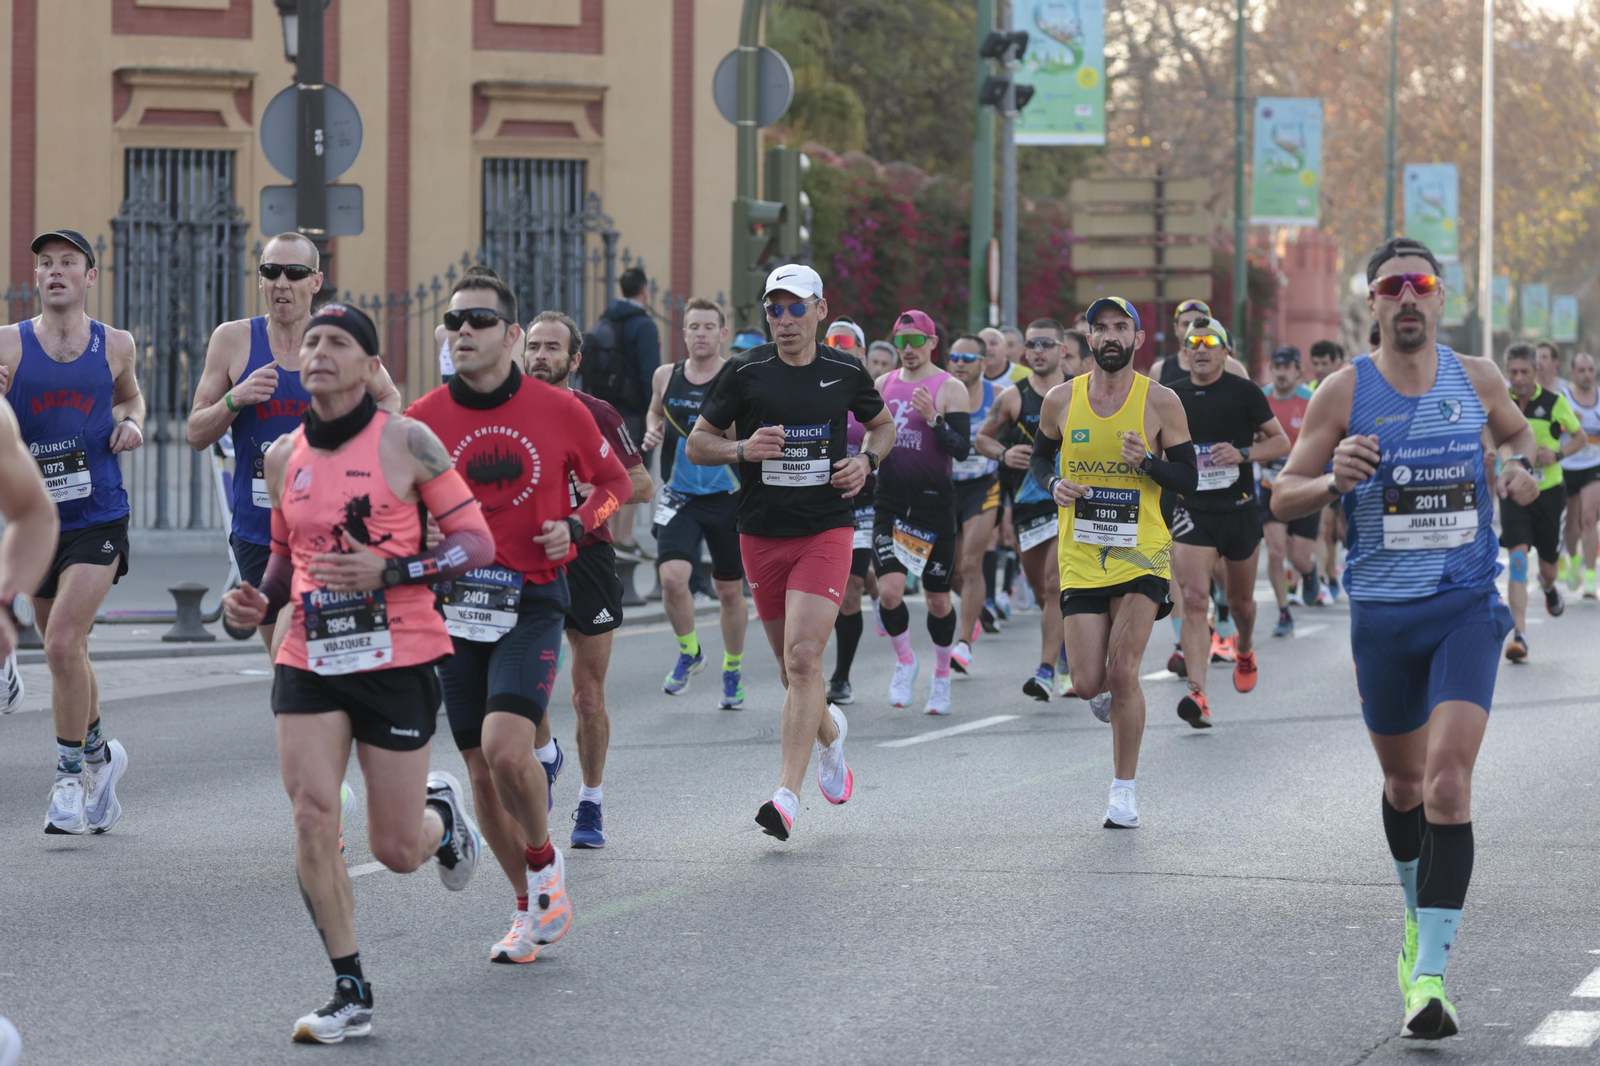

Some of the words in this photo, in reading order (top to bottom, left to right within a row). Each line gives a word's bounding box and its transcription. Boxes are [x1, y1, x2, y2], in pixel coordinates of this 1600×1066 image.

[30, 390, 95, 416] ARENA
[255, 399, 310, 421] AREN
[474, 426, 519, 439] CHICAGO
[785, 428, 822, 438] ZURICH
[40, 439, 76, 454] ZURICH
[785, 447, 808, 458] 2969
[520, 436, 541, 485] MARATHON
[782, 463, 811, 471] BIANCO
[43, 461, 65, 475] 1973
[1415, 466, 1466, 481] ZURICH
[512, 486, 533, 506] 2019
[1095, 491, 1132, 500] ZURICH
[1415, 494, 1447, 510] 2011
[1095, 508, 1117, 519] 1910
[1092, 523, 1118, 532] THIAGO
[1408, 517, 1436, 529] JUAN
[902, 524, 931, 541] ZURICH
[463, 590, 489, 605] 2401
[593, 616, 614, 624] adidas
